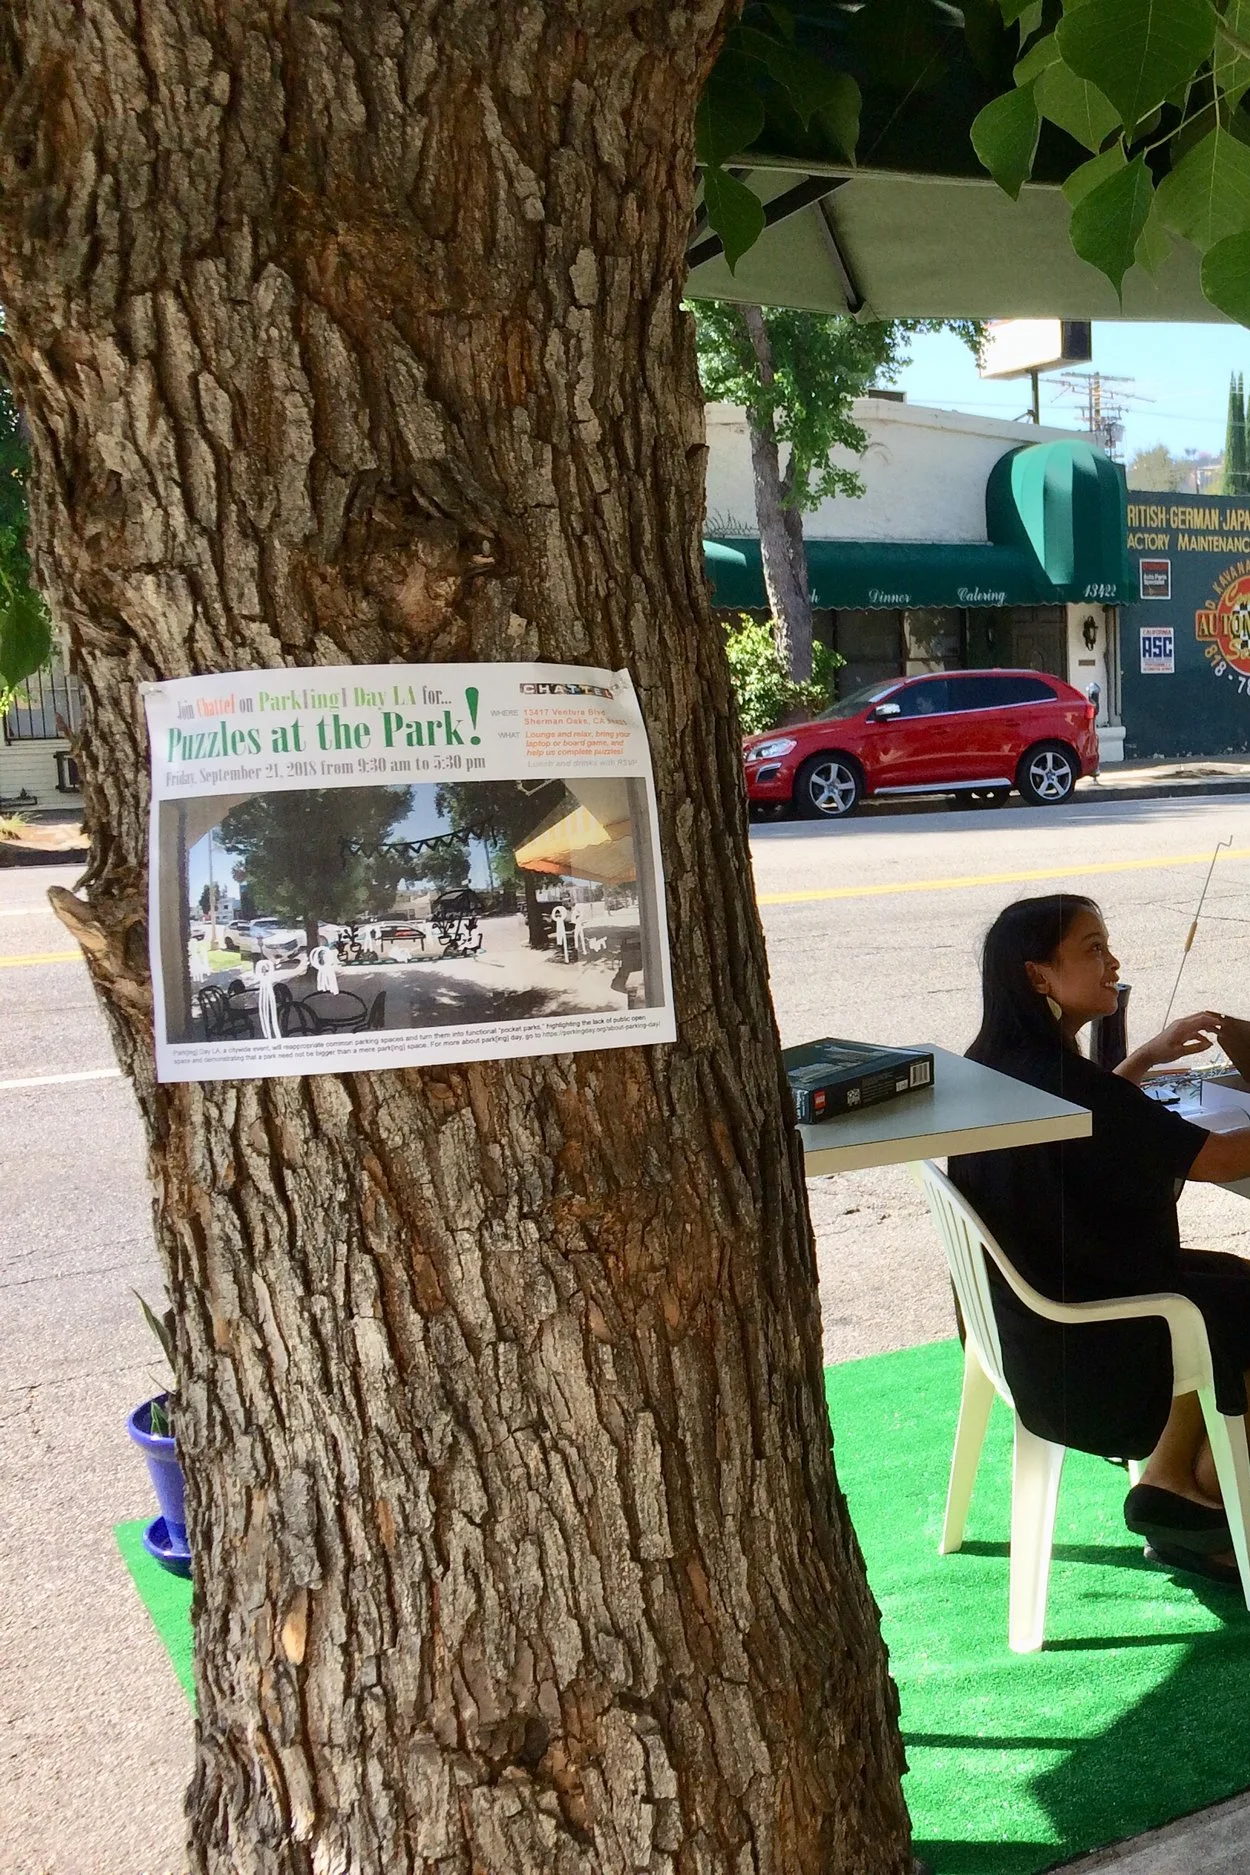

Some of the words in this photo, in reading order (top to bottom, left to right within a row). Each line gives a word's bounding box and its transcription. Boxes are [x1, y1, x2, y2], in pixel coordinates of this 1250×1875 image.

[1127, 504, 1166, 528] RITISH
[1169, 506, 1219, 530] GERMAN
[1127, 532, 1170, 550] ACTORY
[868, 589, 912, 603] Dinner
[956, 587, 1007, 606] Catering
[1142, 636, 1173, 658] ASC
[522, 684, 614, 700] CHATTEL
[177, 700, 195, 720] Join
[196, 693, 236, 718] Chattel
[239, 697, 253, 713] on
[353, 687, 387, 711] Day
[392, 685, 417, 706] LA
[422, 685, 452, 705] for...
[490, 709, 519, 717] WHERE
[551, 708, 586, 717] Ventura
[524, 717, 564, 726] Sherman
[593, 717, 606, 725] CA
[168, 720, 262, 763] Puzzles
[270, 716, 306, 753] at
[316, 714, 372, 751] the
[381, 686, 481, 748] Park!
[498, 731, 520, 739] WHAT
[525, 731, 555, 740] Lounge
[595, 731, 615, 740] bring
[616, 731, 631, 740] your
[526, 739, 550, 748] laptop
[563, 739, 586, 747] board
[527, 748, 544, 757] help
[557, 748, 593, 757] complete
[199, 764, 262, 786] September
[265, 762, 284, 779] 21,
[287, 760, 317, 778] 2018
[320, 759, 354, 776] from
[357, 756, 387, 774] 9:30
[390, 759, 411, 773] am
[416, 757, 430, 771] to
[433, 754, 462, 771] 5:30
[466, 756, 486, 773] pm
[617, 759, 638, 767] RSVP
[283, 1042, 324, 1052] reappropriate
[326, 1039, 354, 1047] common
[355, 1037, 379, 1046] parking
[380, 1036, 404, 1045] spaces
[406, 1034, 418, 1042] and
[420, 1033, 432, 1041] turn
[434, 1032, 450, 1040] them
[452, 1030, 464, 1038] into
[465, 1028, 497, 1037] functional
[546, 1020, 580, 1030] highlighting
[582, 1018, 591, 1026] the
[593, 1017, 604, 1025] lack
[606, 1016, 612, 1024] of
[613, 1015, 630, 1024] public
[631, 1014, 646, 1023] open
[192, 1056, 203, 1064] and
[204, 1054, 244, 1064] demonstrating
[263, 1052, 277, 1061] park
[278, 1051, 294, 1059] need
[306, 1049, 314, 1057] be
[316, 1048, 336, 1058] bigger
[337, 1047, 352, 1055] than
[430, 1040, 442, 1048] For
[443, 1039, 460, 1047] more
[461, 1037, 480, 1046] about
[525, 1033, 533, 1041] go
